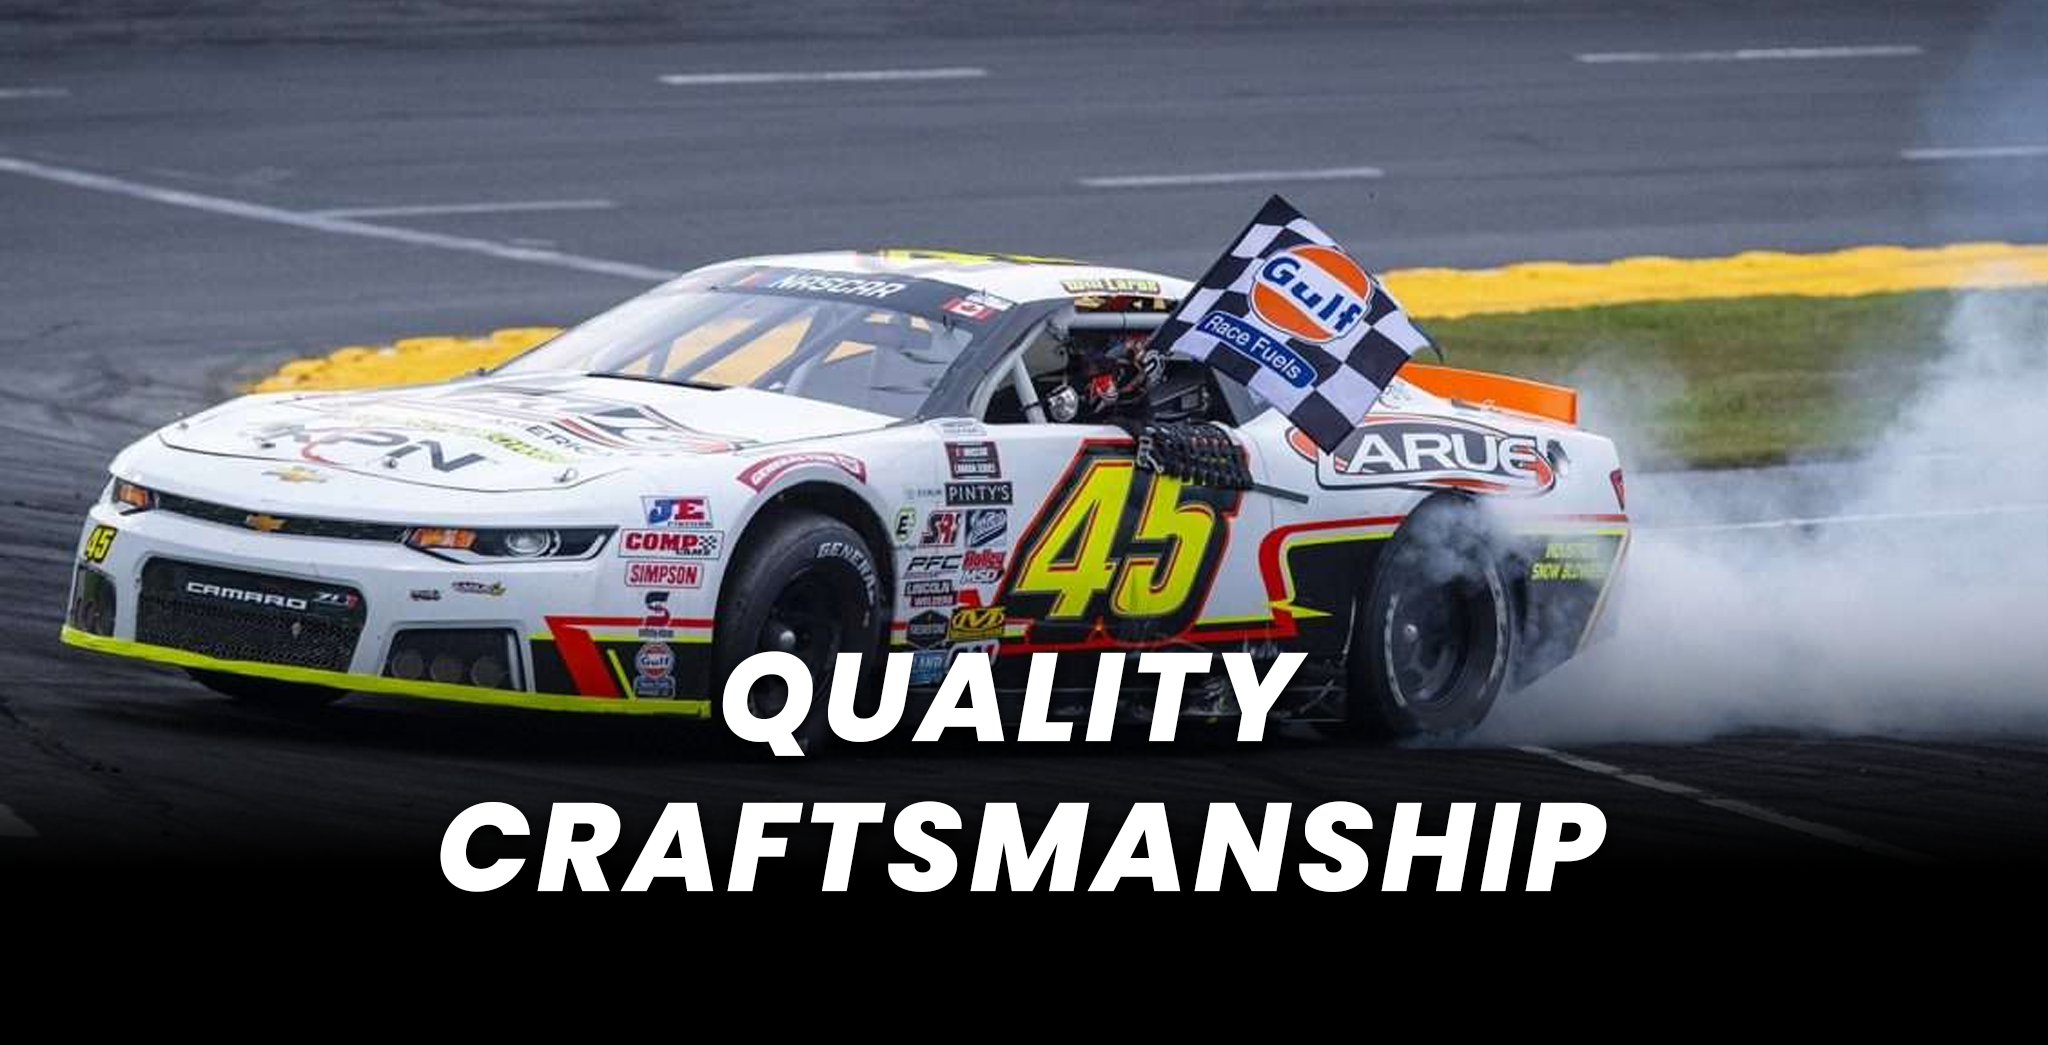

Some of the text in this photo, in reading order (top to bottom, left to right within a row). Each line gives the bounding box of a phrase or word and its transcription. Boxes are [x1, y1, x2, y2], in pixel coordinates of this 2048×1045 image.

[768, 273, 907, 298] NASCAR
[1261, 256, 1362, 333] Gulf
[1204, 315, 1300, 380] Race Fuels
[949, 484, 1009, 501] PINTY'S
[649, 499, 705, 526] JE
[86, 525, 118, 563] 45
[625, 532, 697, 552] COMP
[1012, 456, 1222, 622] 45
[629, 564, 697, 586] SIMPSON
[816, 541, 877, 606] GENERAL
[907, 554, 962, 571] PFC
[186, 581, 308, 610] CAMARO
